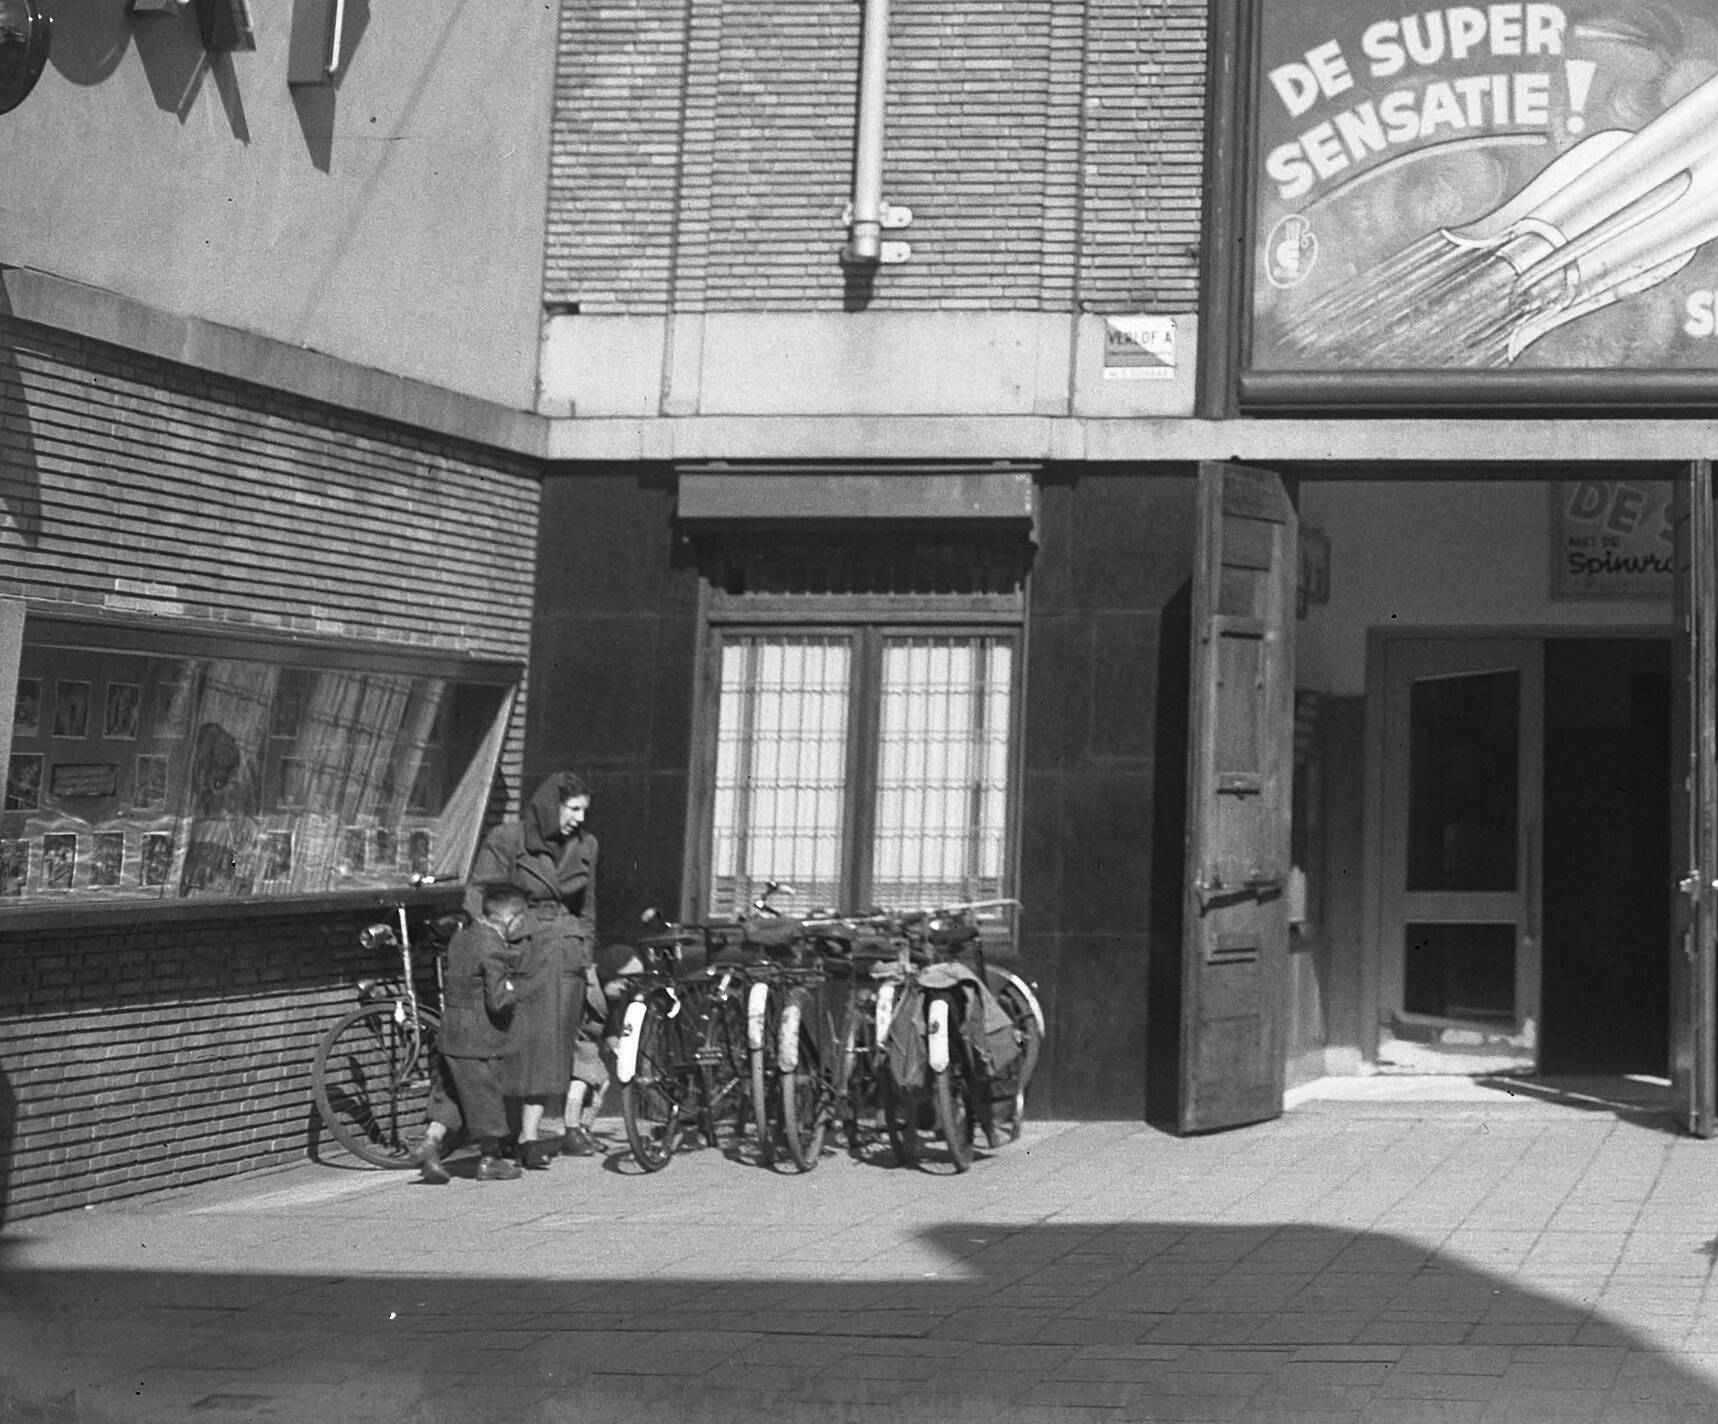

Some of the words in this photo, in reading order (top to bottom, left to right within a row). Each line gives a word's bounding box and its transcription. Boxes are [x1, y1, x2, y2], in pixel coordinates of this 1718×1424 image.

[1268, 39, 1354, 117] DE
[1361, 2, 1568, 79] SUPER
[1567, 480, 1646, 536] DE
